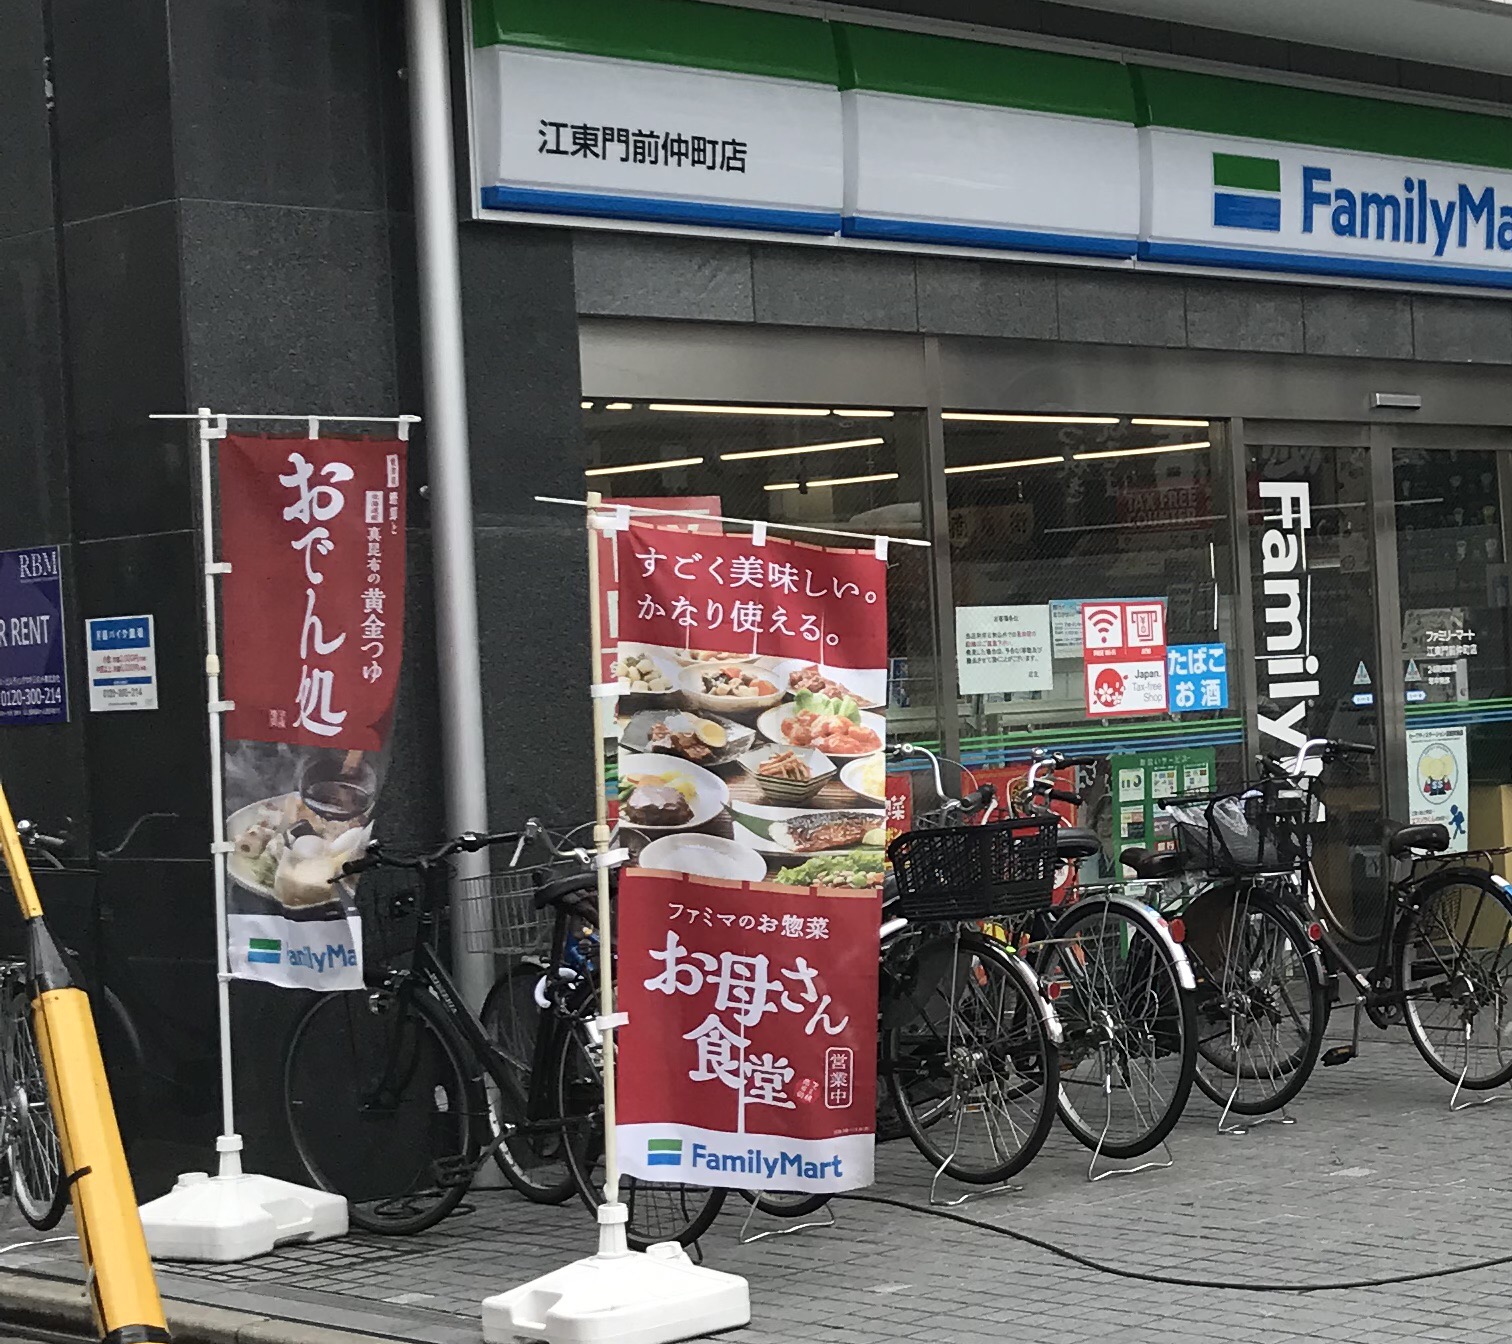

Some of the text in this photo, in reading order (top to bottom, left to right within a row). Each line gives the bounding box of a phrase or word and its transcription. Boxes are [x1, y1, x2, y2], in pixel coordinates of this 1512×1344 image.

[537, 118, 748, 174] 江東門前仲町店
[19, 551, 58, 578] RBM
[635, 546, 878, 605] すごく美味しい。
[278, 452, 355, 737] おでん処
[11, 614, 51, 646] RENT
[637, 593, 840, 647] かなり使える。
[1425, 629, 1476, 643] ファミリーマート
[1167, 646, 1226, 676] たばこ
[1, 686, 62, 707] 0120-300-214
[1132, 682, 1163, 692] Tax-free
[1143, 692, 1163, 703] Shop
[1175, 678, 1222, 708] お酒
[667, 902, 831, 940] ファミマのお惣菜
[643, 929, 850, 1036] お母さん
[682, 1013, 797, 1110] 食堂
[829, 1053, 849, 1104] 営業中
[691, 1143, 843, 1180] FamilyMart
